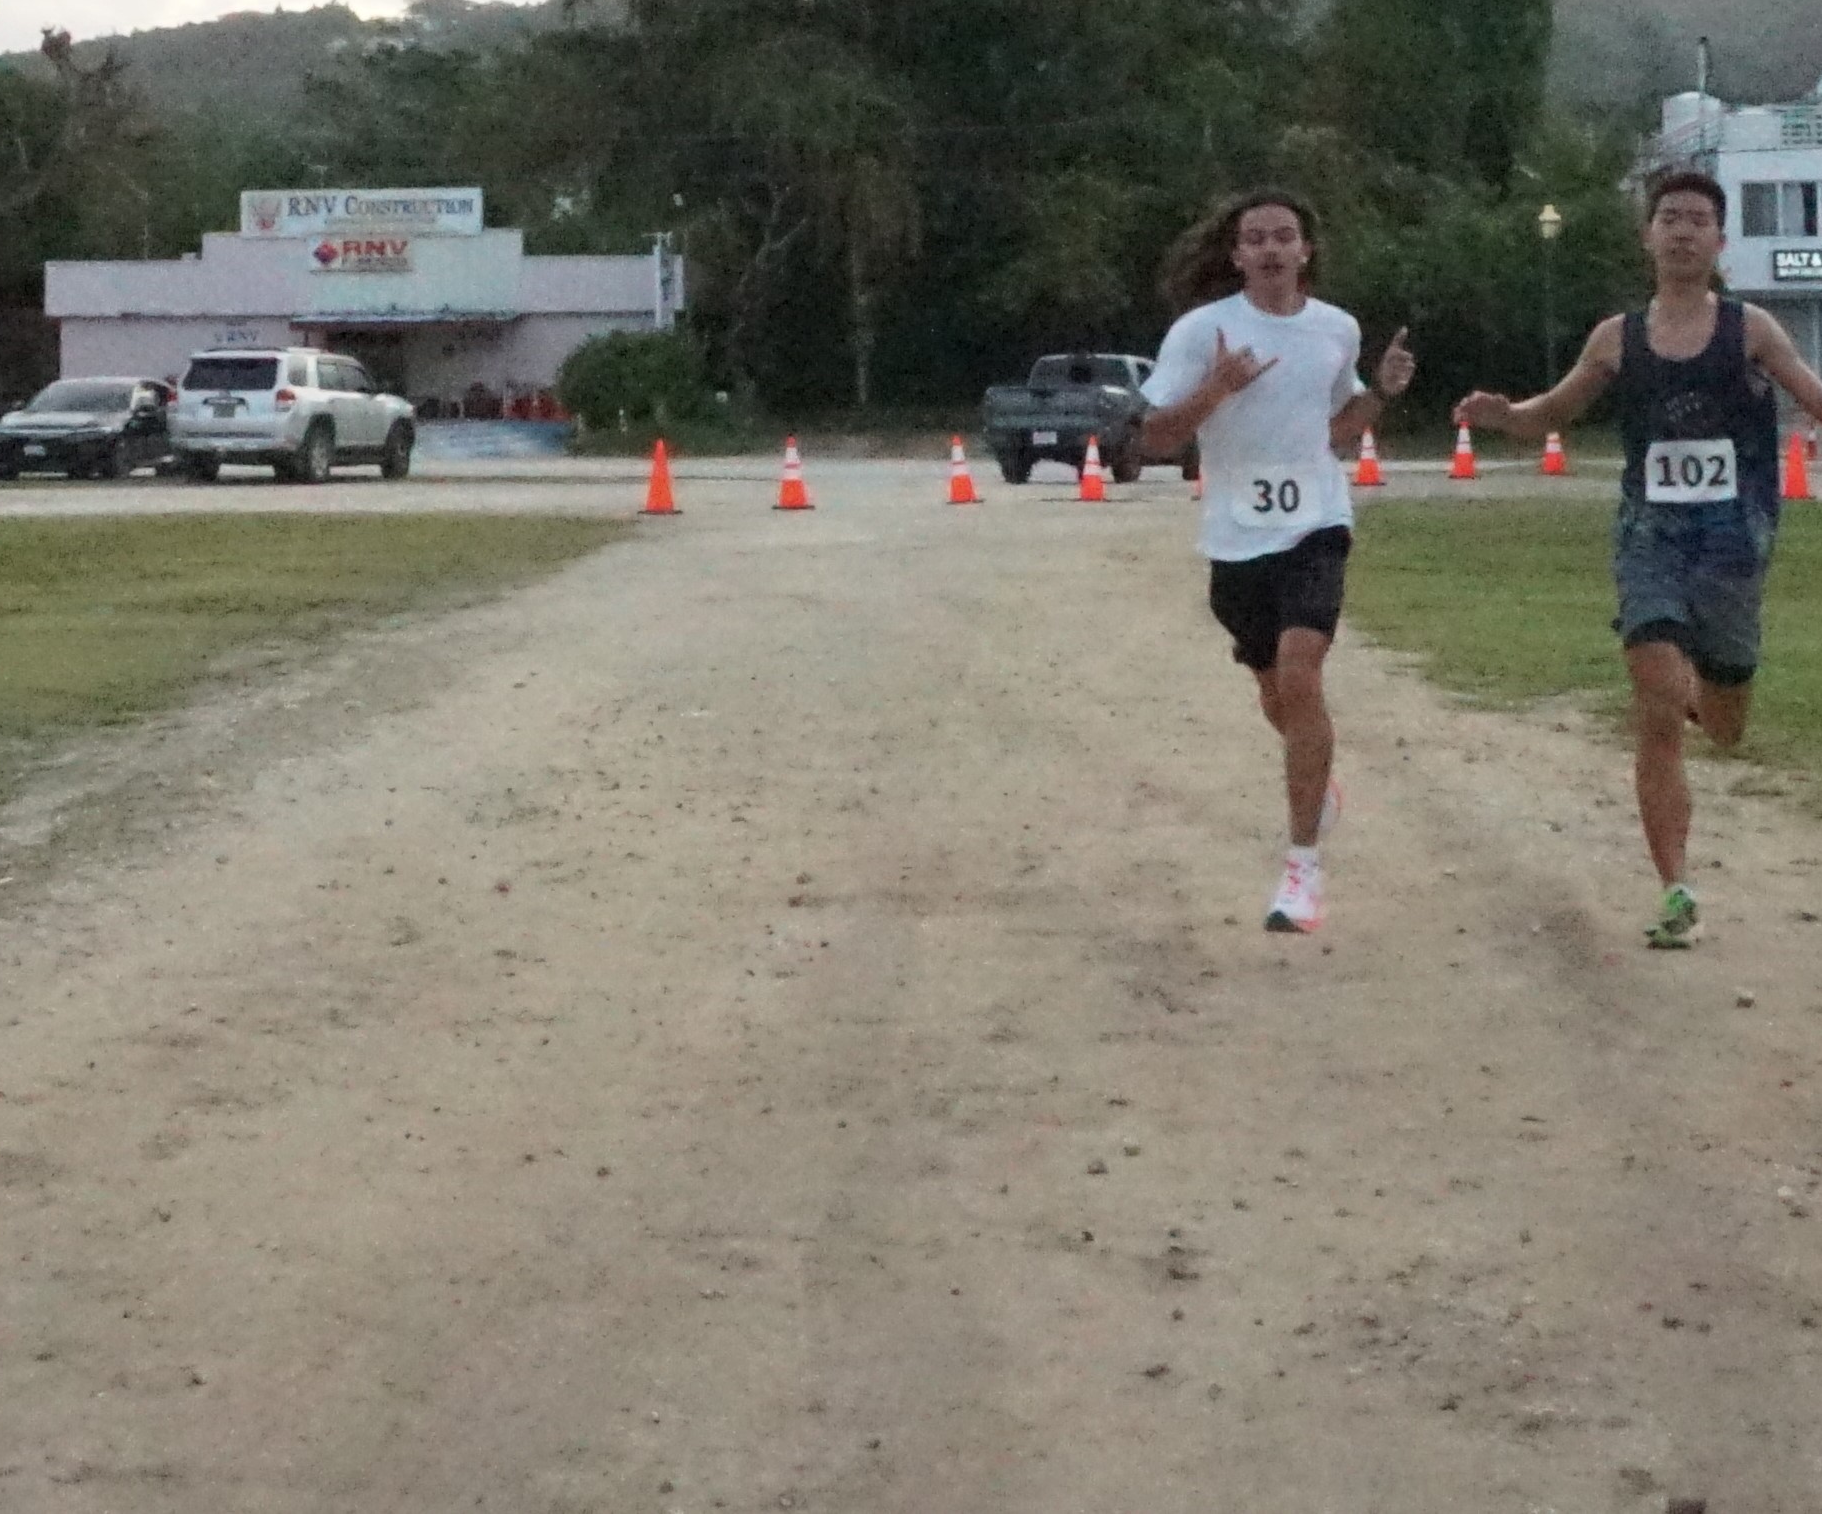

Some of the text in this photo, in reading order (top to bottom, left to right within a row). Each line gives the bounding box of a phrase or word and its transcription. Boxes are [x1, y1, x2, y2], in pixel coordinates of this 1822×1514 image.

[287, 195, 336, 217] RNV
[341, 240, 408, 256] RNV
[1776, 252, 1810, 267] SALT
[1656, 454, 1728, 487] 102
[1253, 479, 1300, 513] 30
